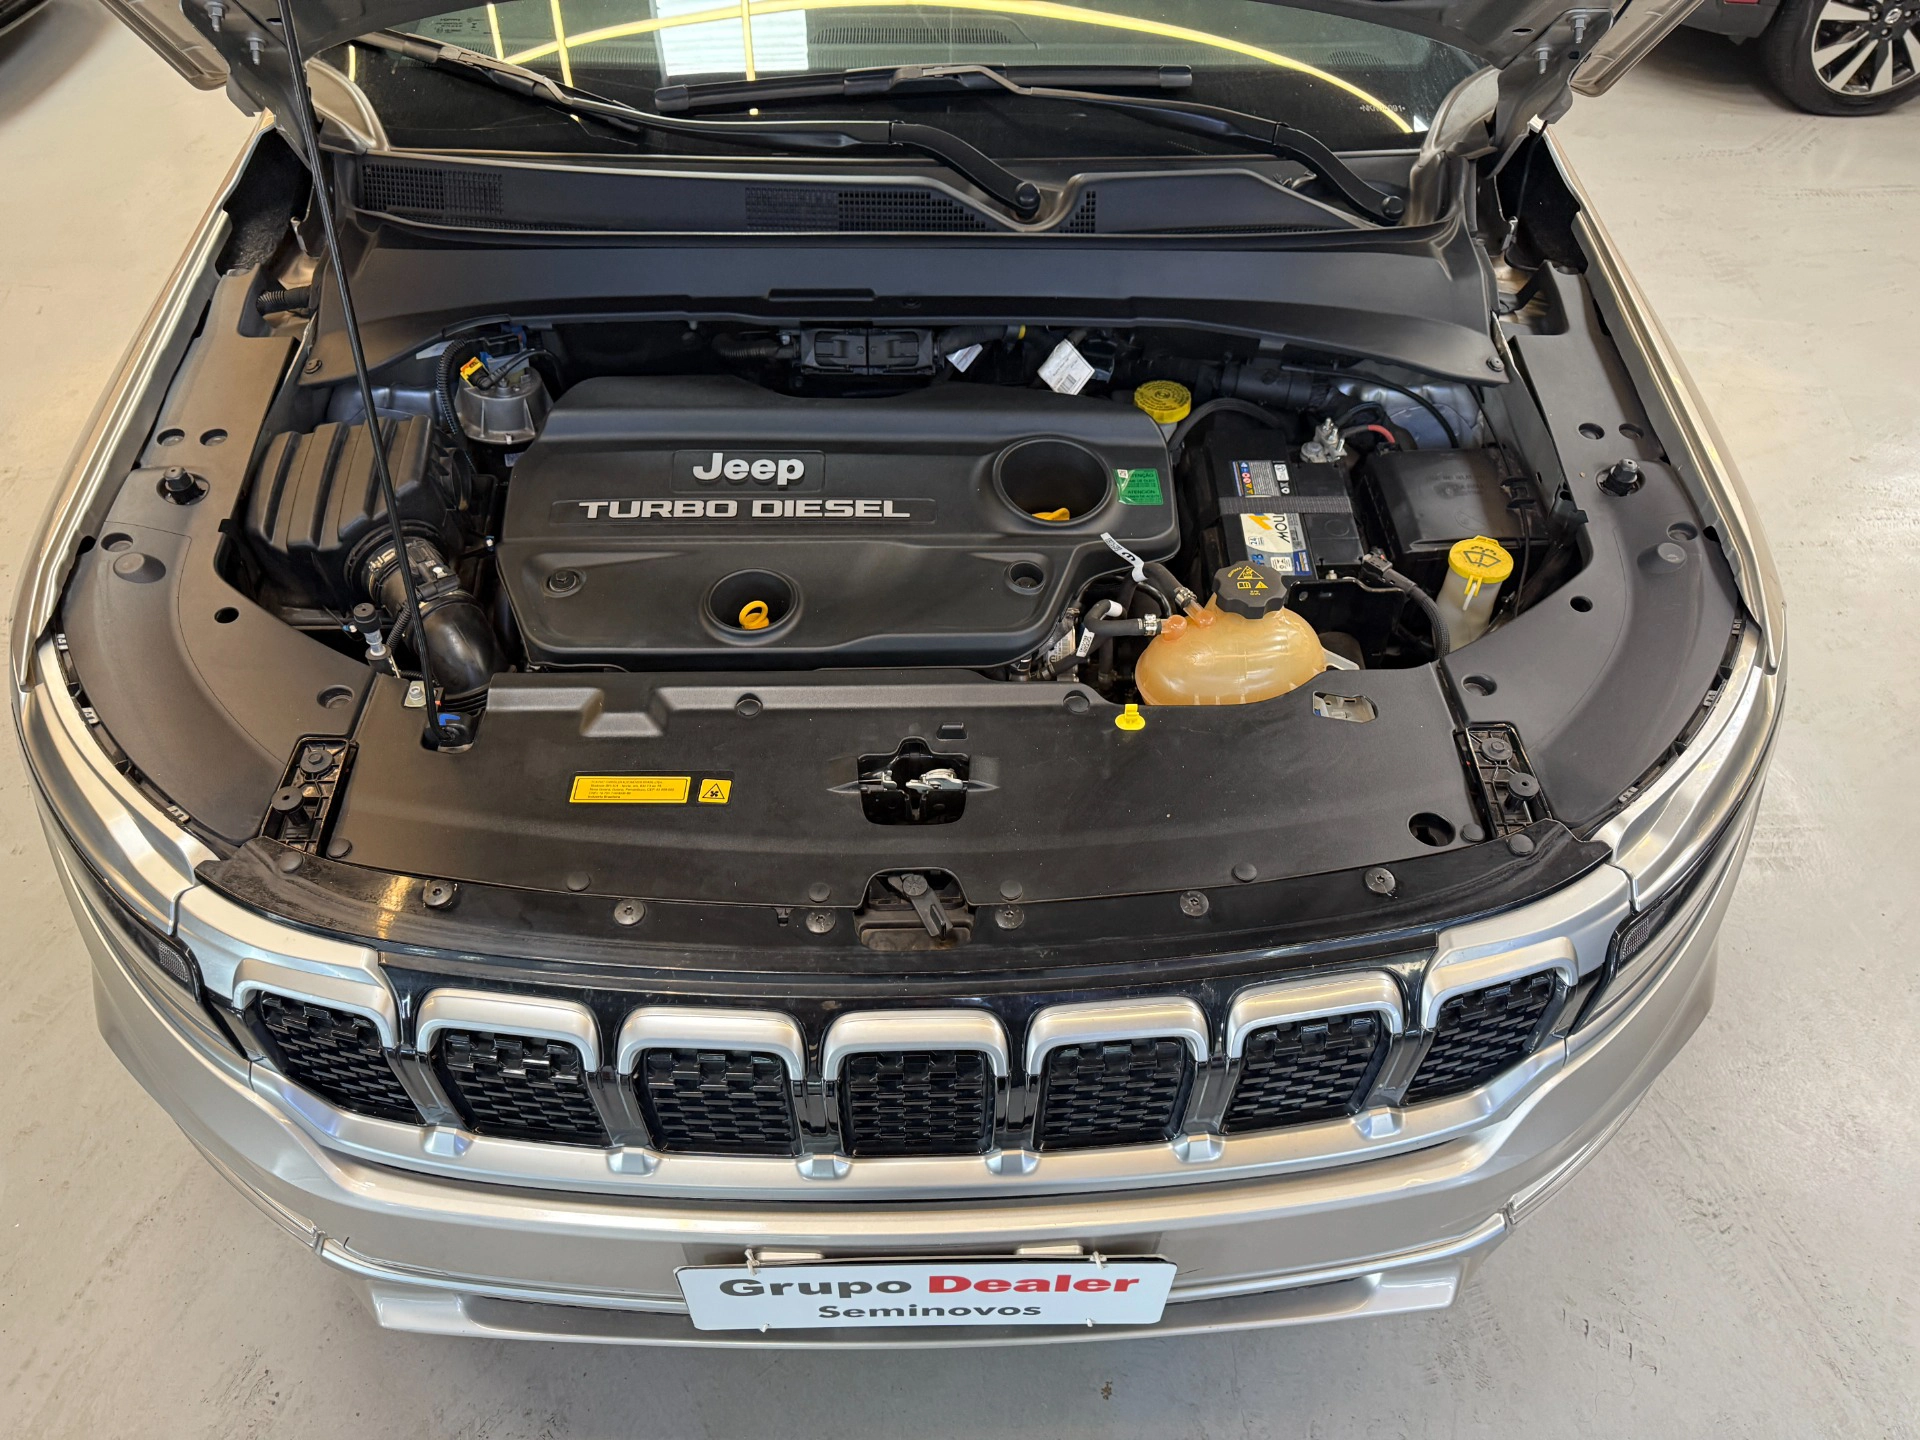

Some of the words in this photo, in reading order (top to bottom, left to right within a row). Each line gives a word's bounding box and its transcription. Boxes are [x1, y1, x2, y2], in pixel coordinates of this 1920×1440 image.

[692, 452, 805, 487] Jeep
[578, 500, 738, 519] TURBO
[751, 499, 911, 518] DIESEL
[1273, 513, 1291, 544] MOU
[719, 1278, 912, 1299] Grupo
[928, 1274, 1139, 1293] Dealer
[818, 1304, 1042, 1319] Seminovos
